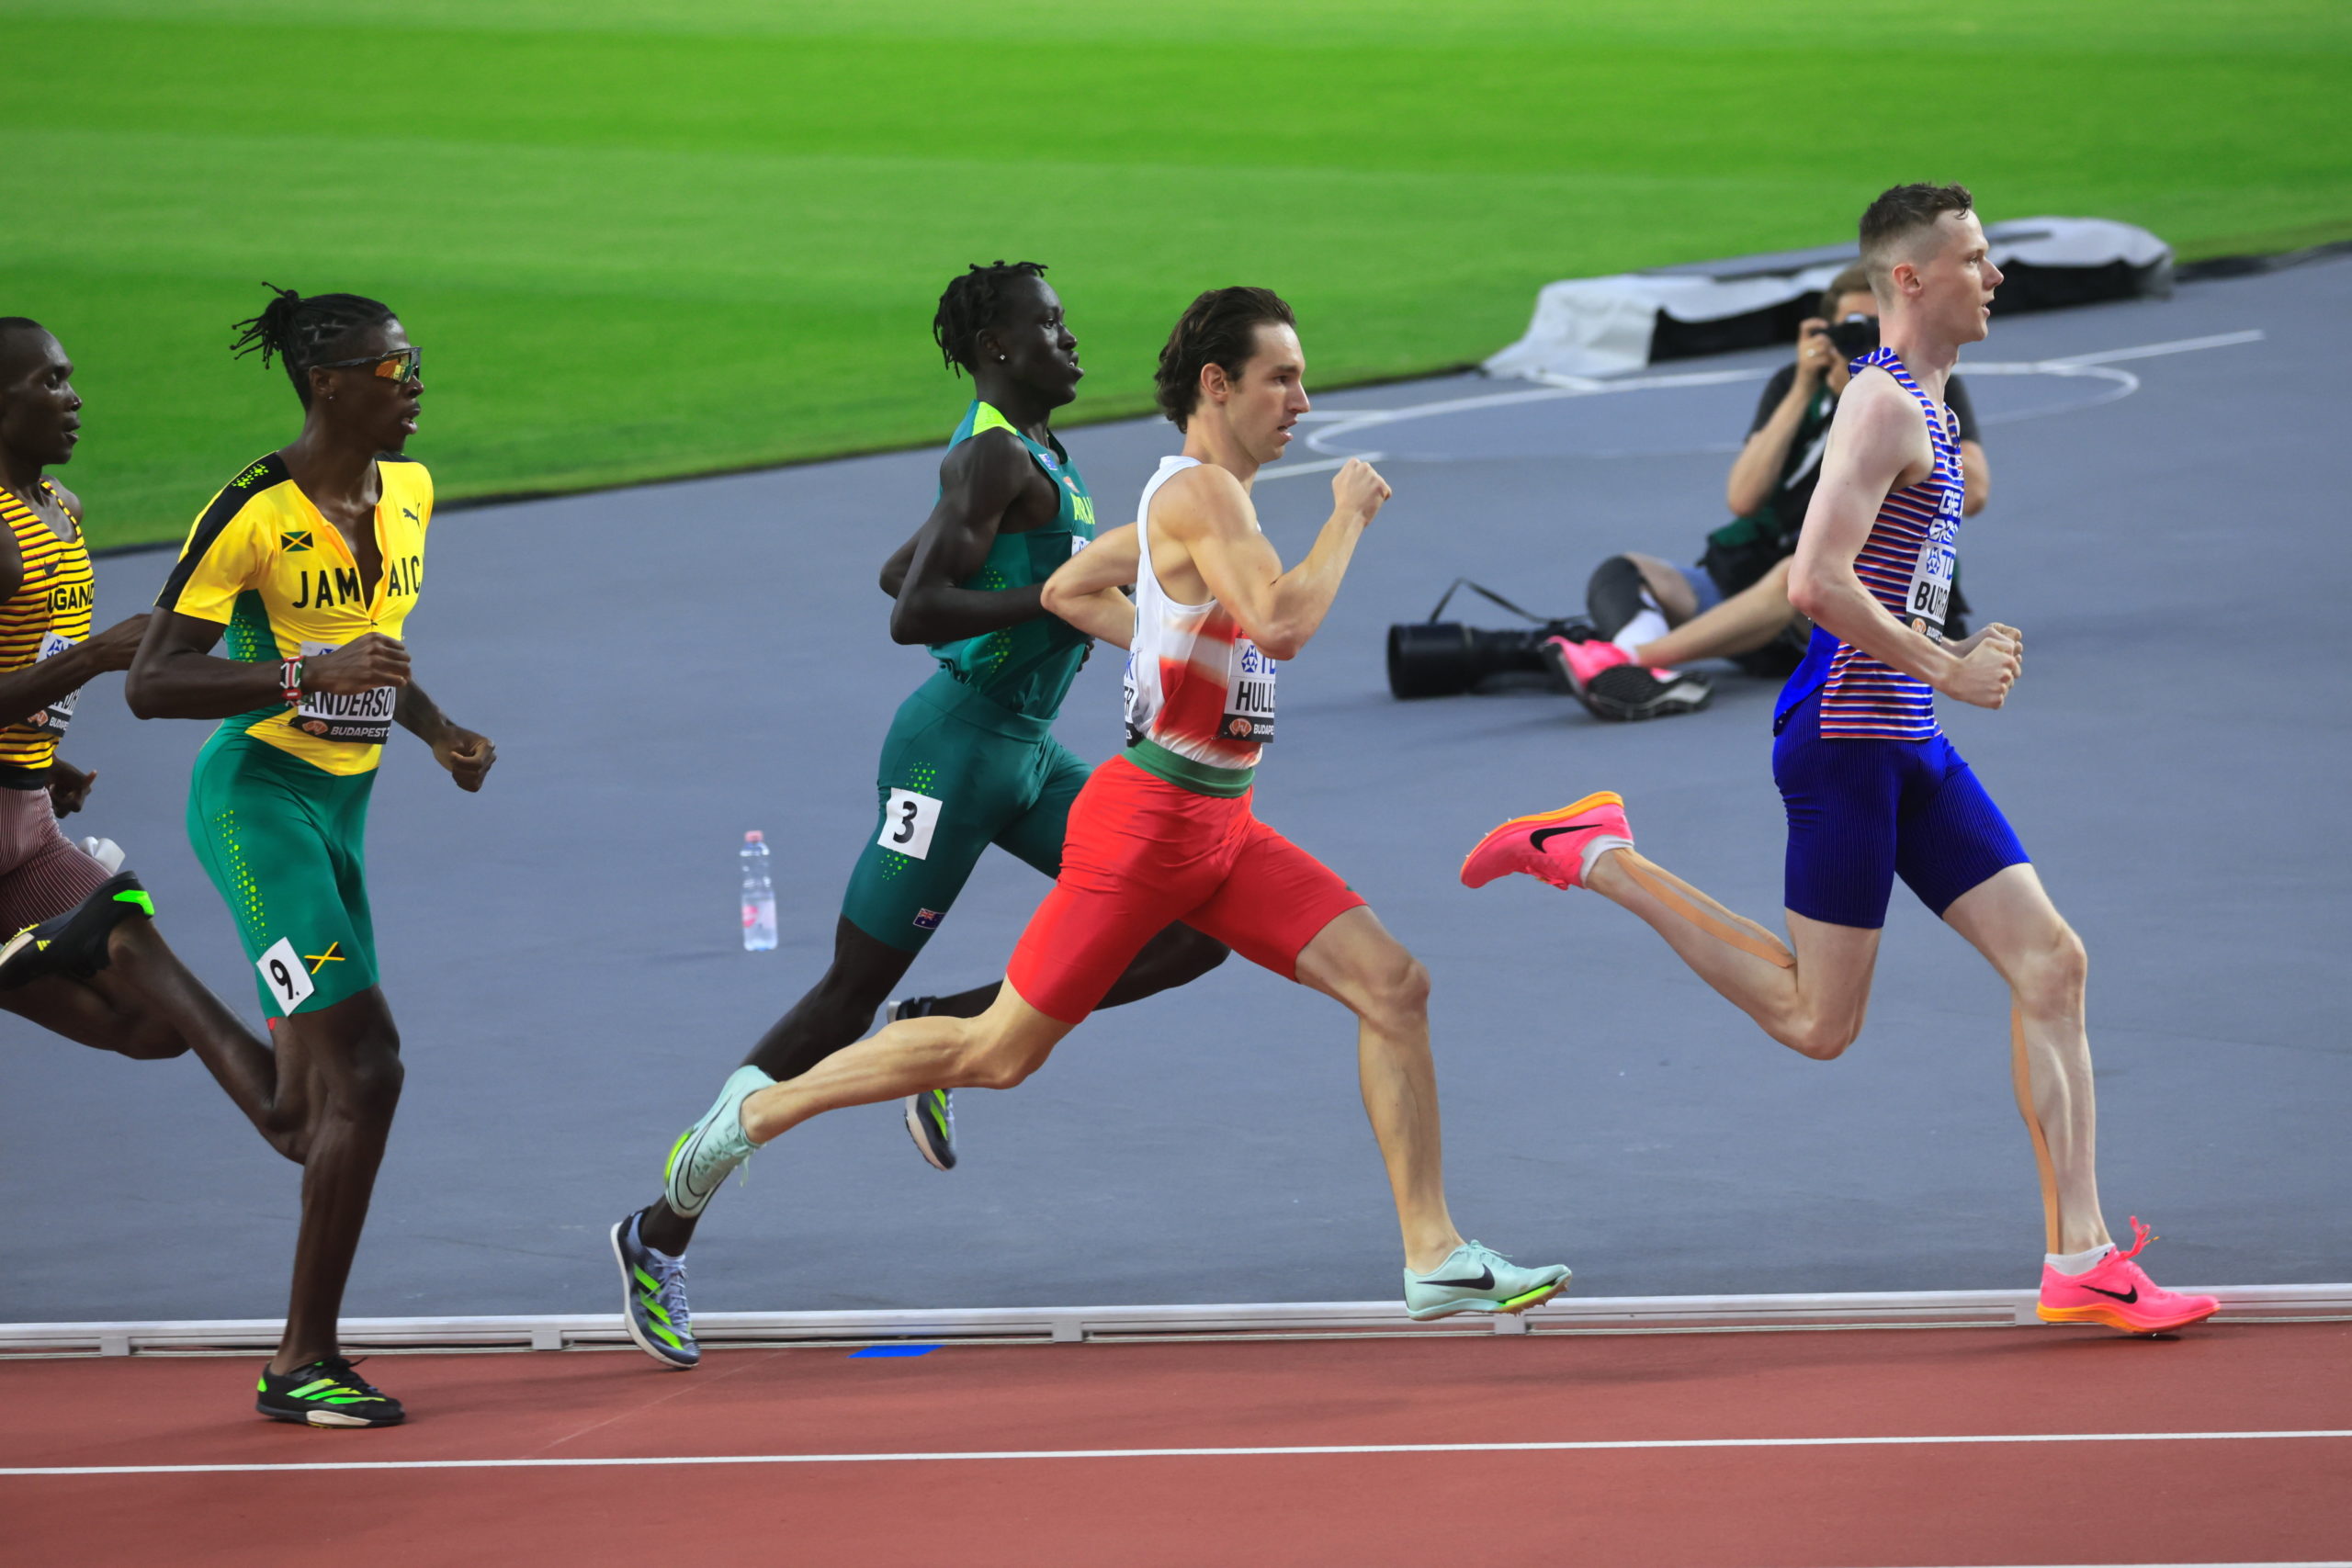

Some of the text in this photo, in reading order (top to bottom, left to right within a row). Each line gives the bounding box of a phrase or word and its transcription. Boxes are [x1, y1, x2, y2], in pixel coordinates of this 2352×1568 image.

[47, 581, 95, 614] UGAND
[292, 555, 421, 609] JAMAIC
[304, 687, 395, 716] ANDERSO
[331, 726, 387, 738] BUDAPEST
[1253, 723, 1275, 735] BUDAPE
[893, 801, 918, 843] 3
